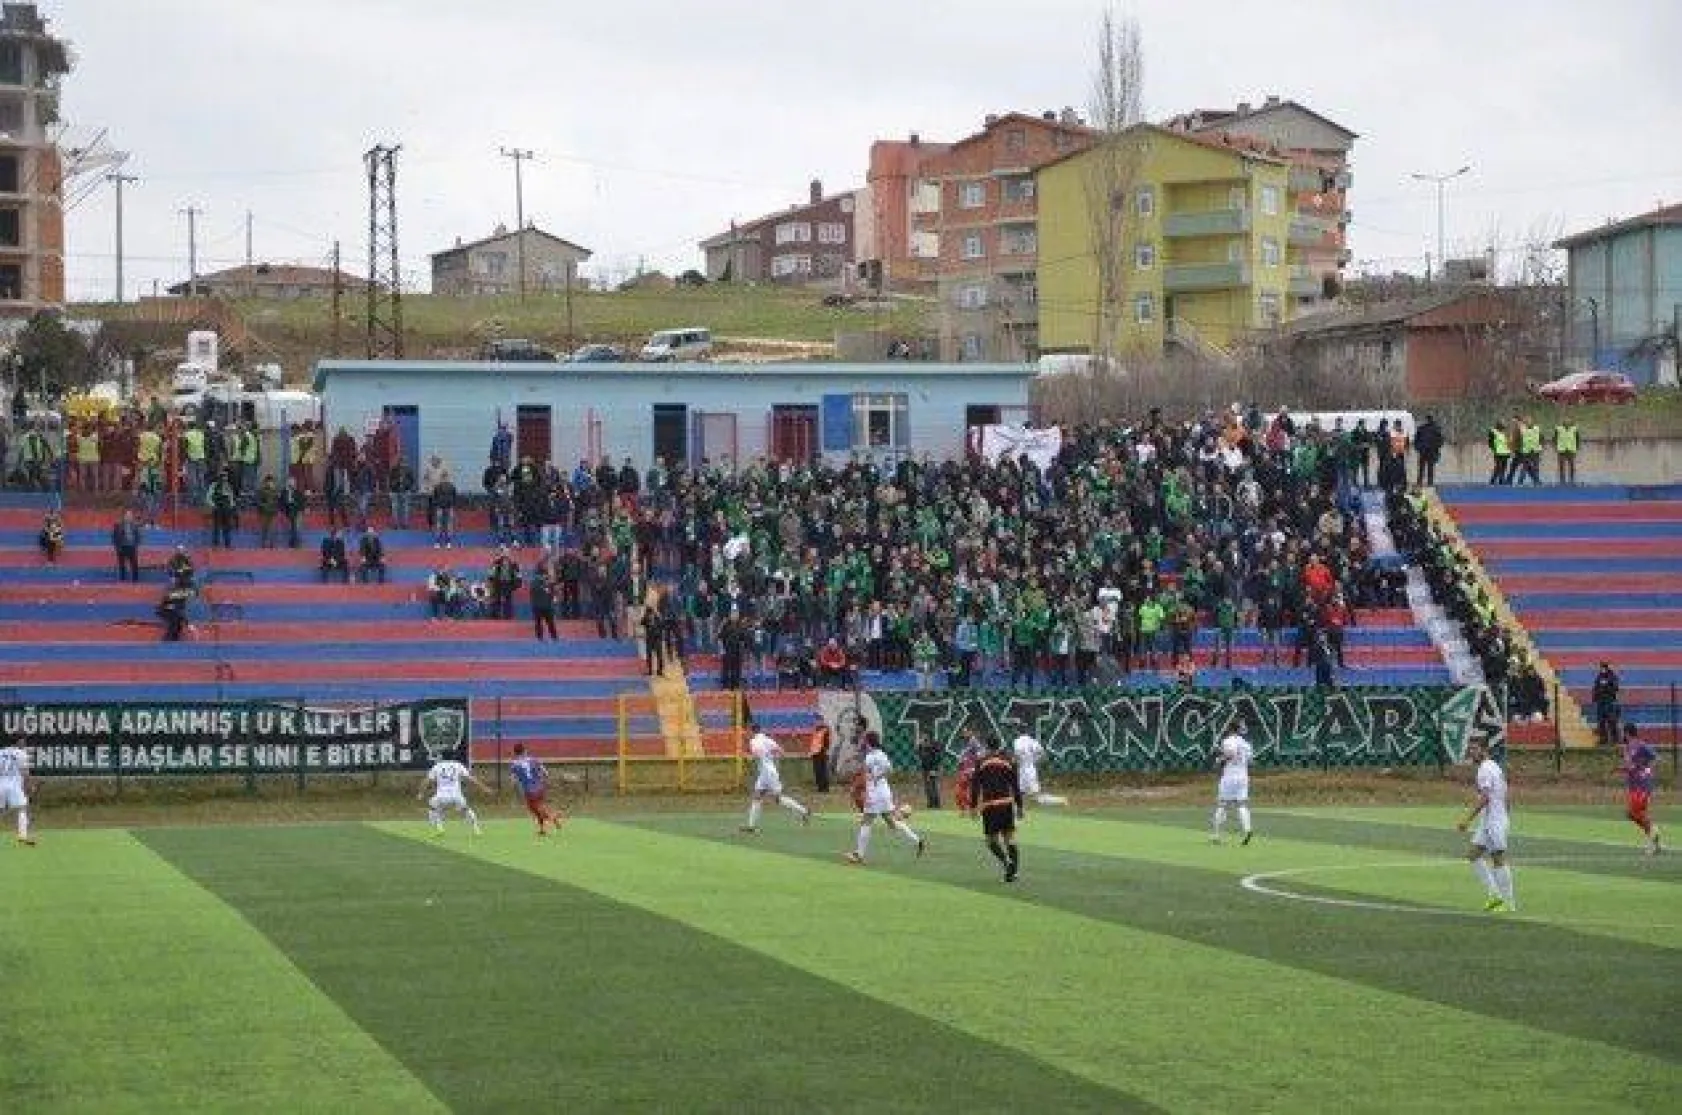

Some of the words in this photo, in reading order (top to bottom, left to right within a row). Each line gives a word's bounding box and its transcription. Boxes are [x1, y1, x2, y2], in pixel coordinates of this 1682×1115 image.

[4, 706, 111, 734] UĞRUNA
[121, 710, 233, 739] ADANMIŞ
[22, 745, 110, 768] ENİNLE
